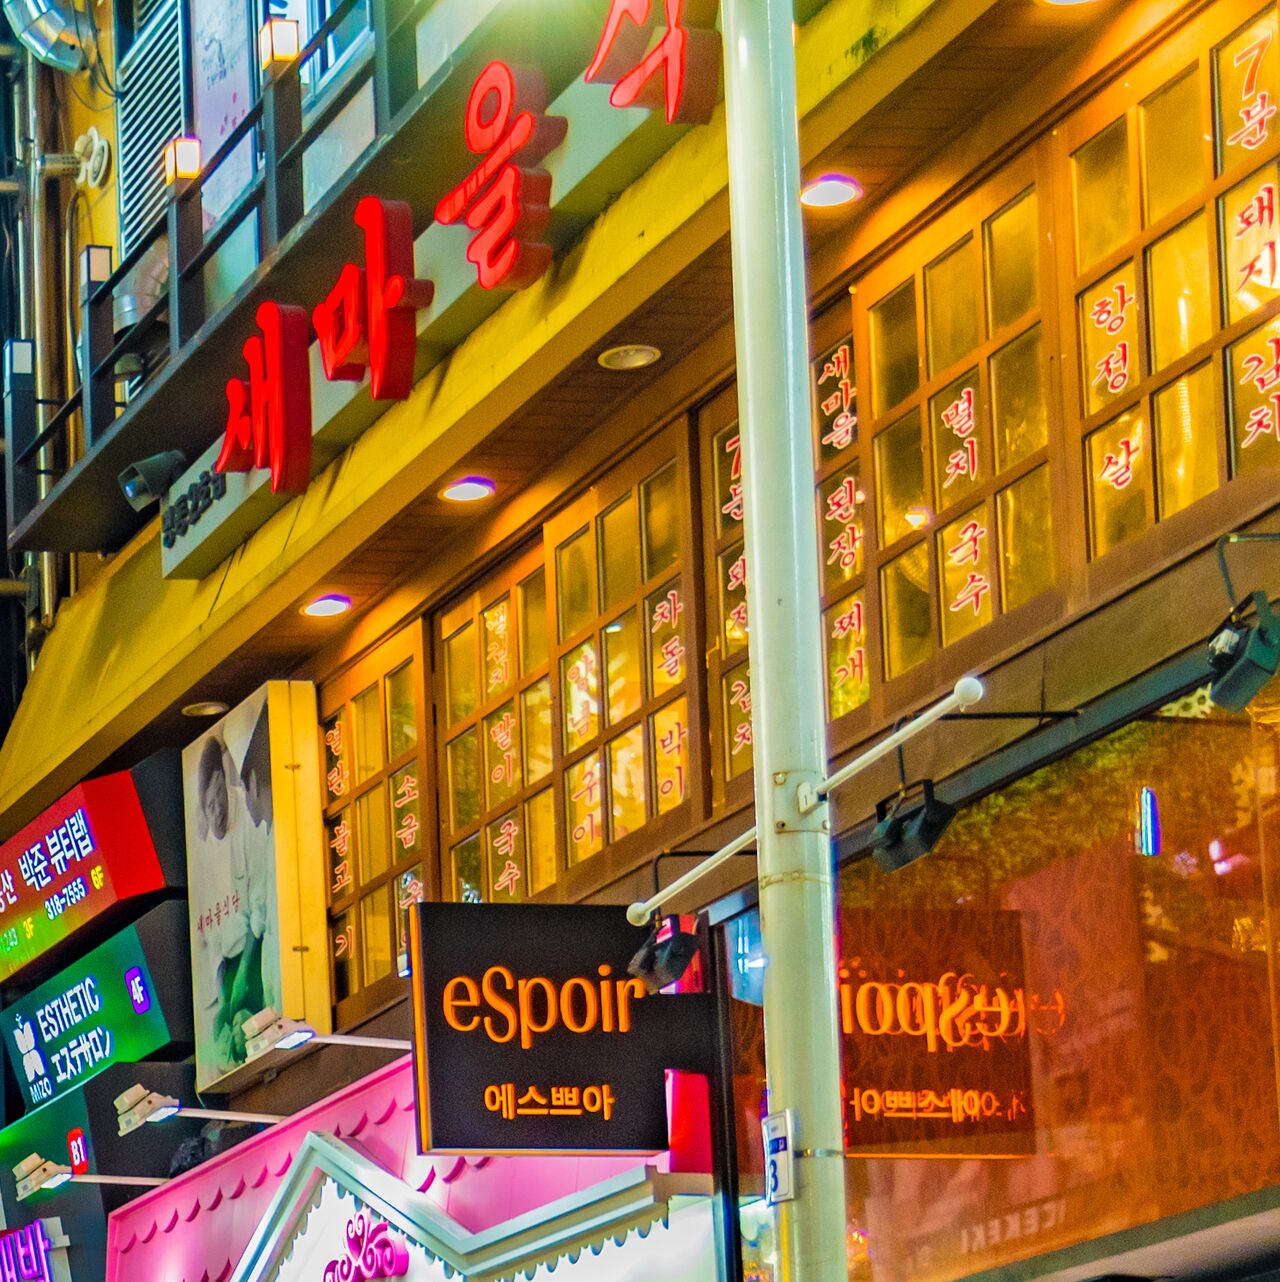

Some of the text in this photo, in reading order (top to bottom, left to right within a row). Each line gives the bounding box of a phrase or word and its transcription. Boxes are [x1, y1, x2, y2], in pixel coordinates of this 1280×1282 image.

[817, 345, 858, 449] 새마을
[17, 841, 52, 891] 박준
[45, 808, 95, 877] 뷰티랩
[44, 864, 106, 921] 318-7555 6F
[35, 975, 145, 1043] ESTHETIC 4F
[50, 1026, 112, 1084] エステサロン
[28, 1076, 53, 1105] MIZO
[483, 1083, 616, 1121] 에스쁘아
[70, 1135, 88, 1167] B1
